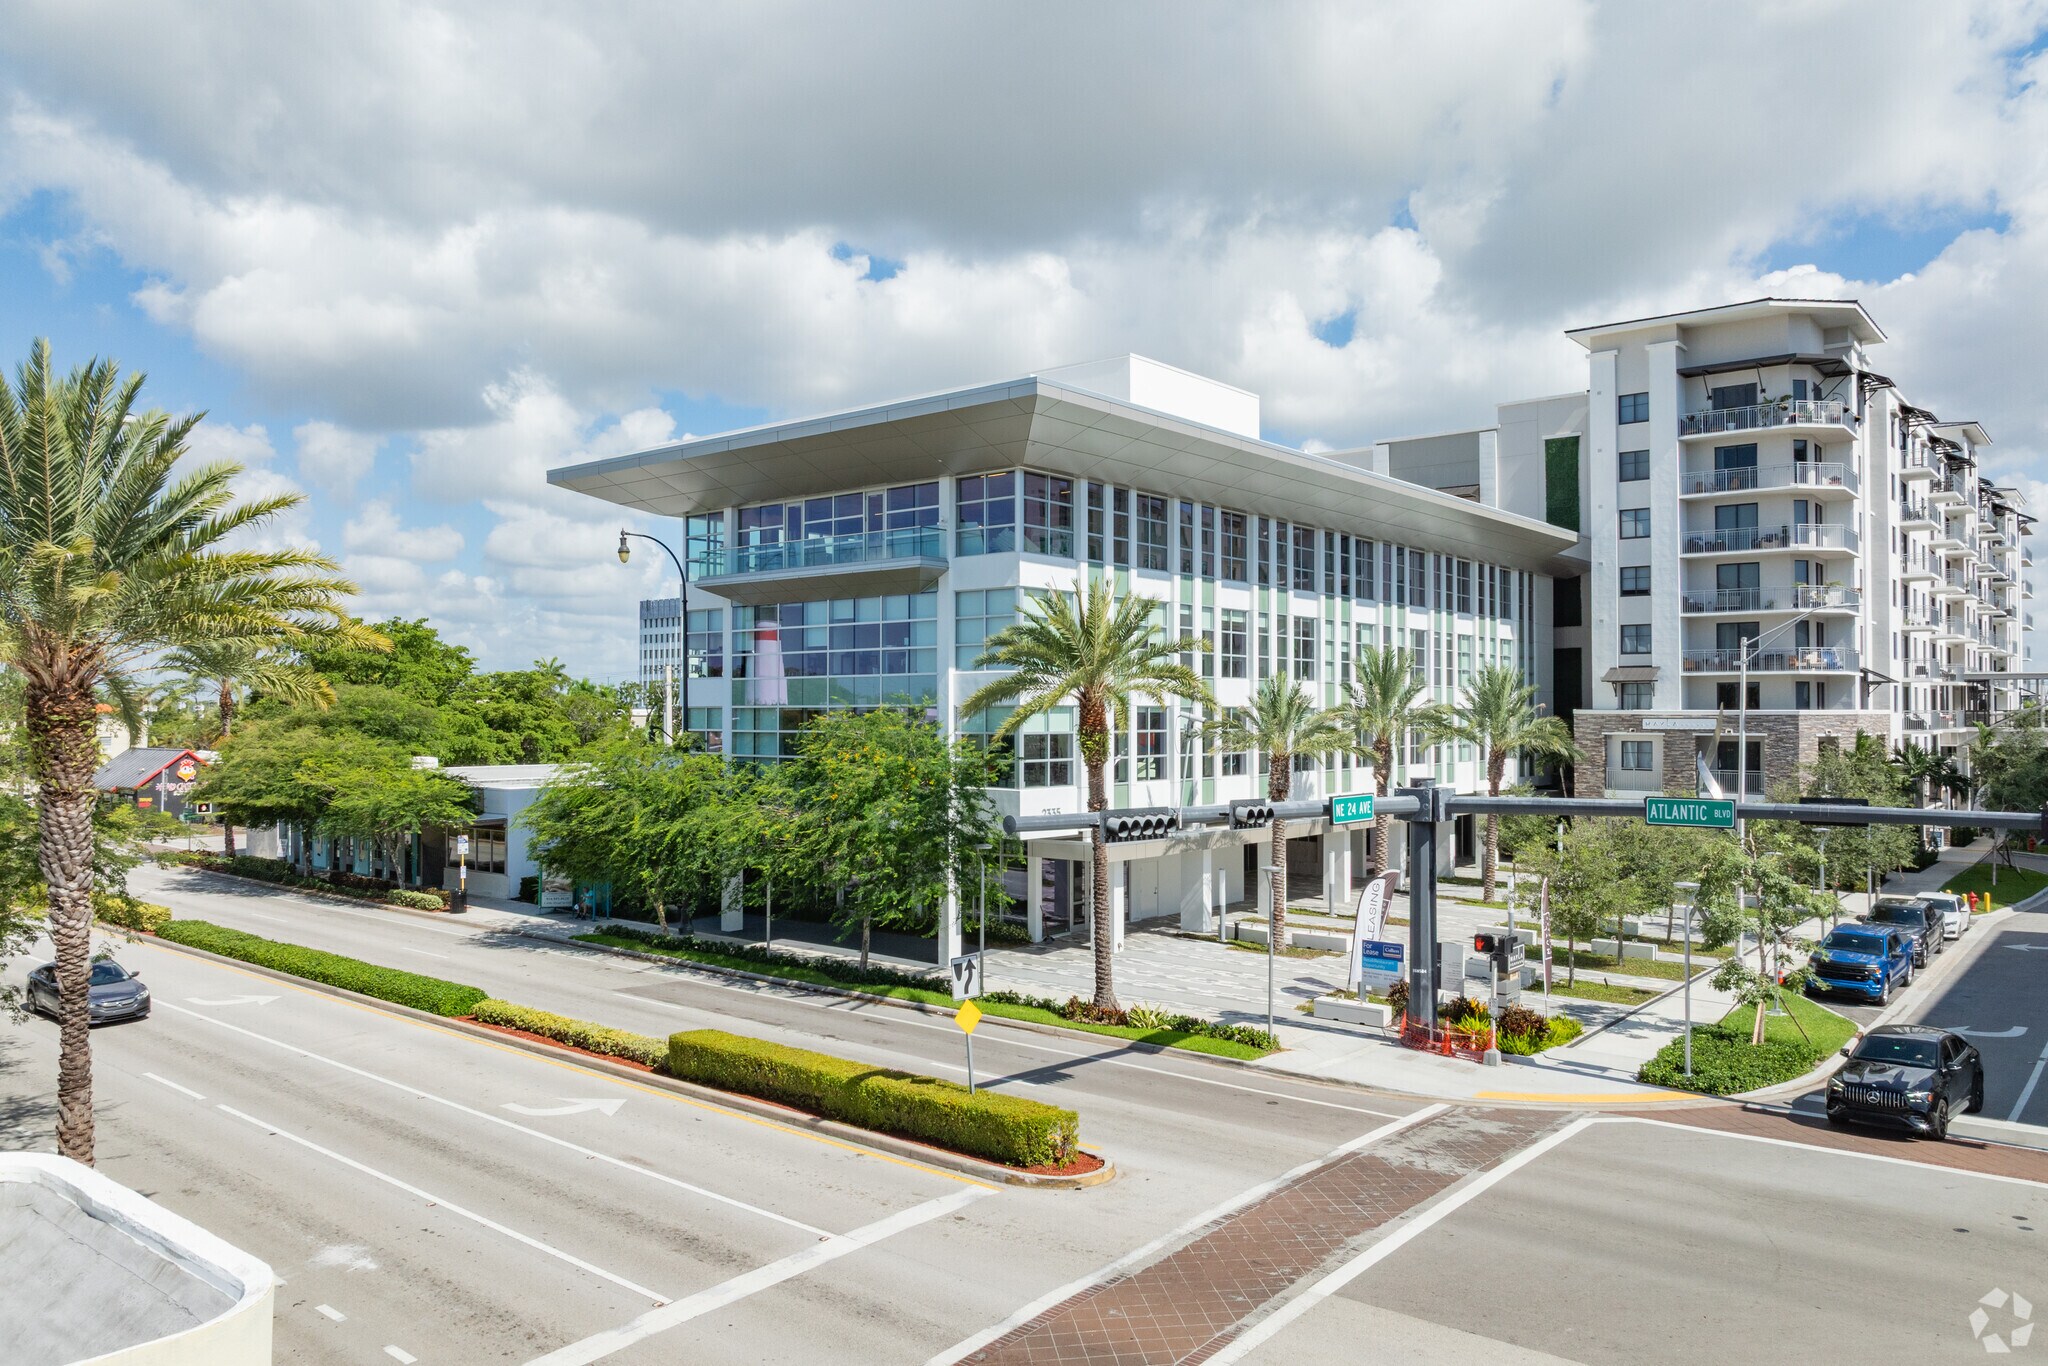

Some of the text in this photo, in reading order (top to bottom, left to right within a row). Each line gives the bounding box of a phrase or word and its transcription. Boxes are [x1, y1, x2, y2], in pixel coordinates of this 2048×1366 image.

[1336, 801, 1371, 817] NE 24 AVE
[1650, 803, 1731, 821] ATLANTIC BLVD
[1367, 882, 1381, 941] LEASING
